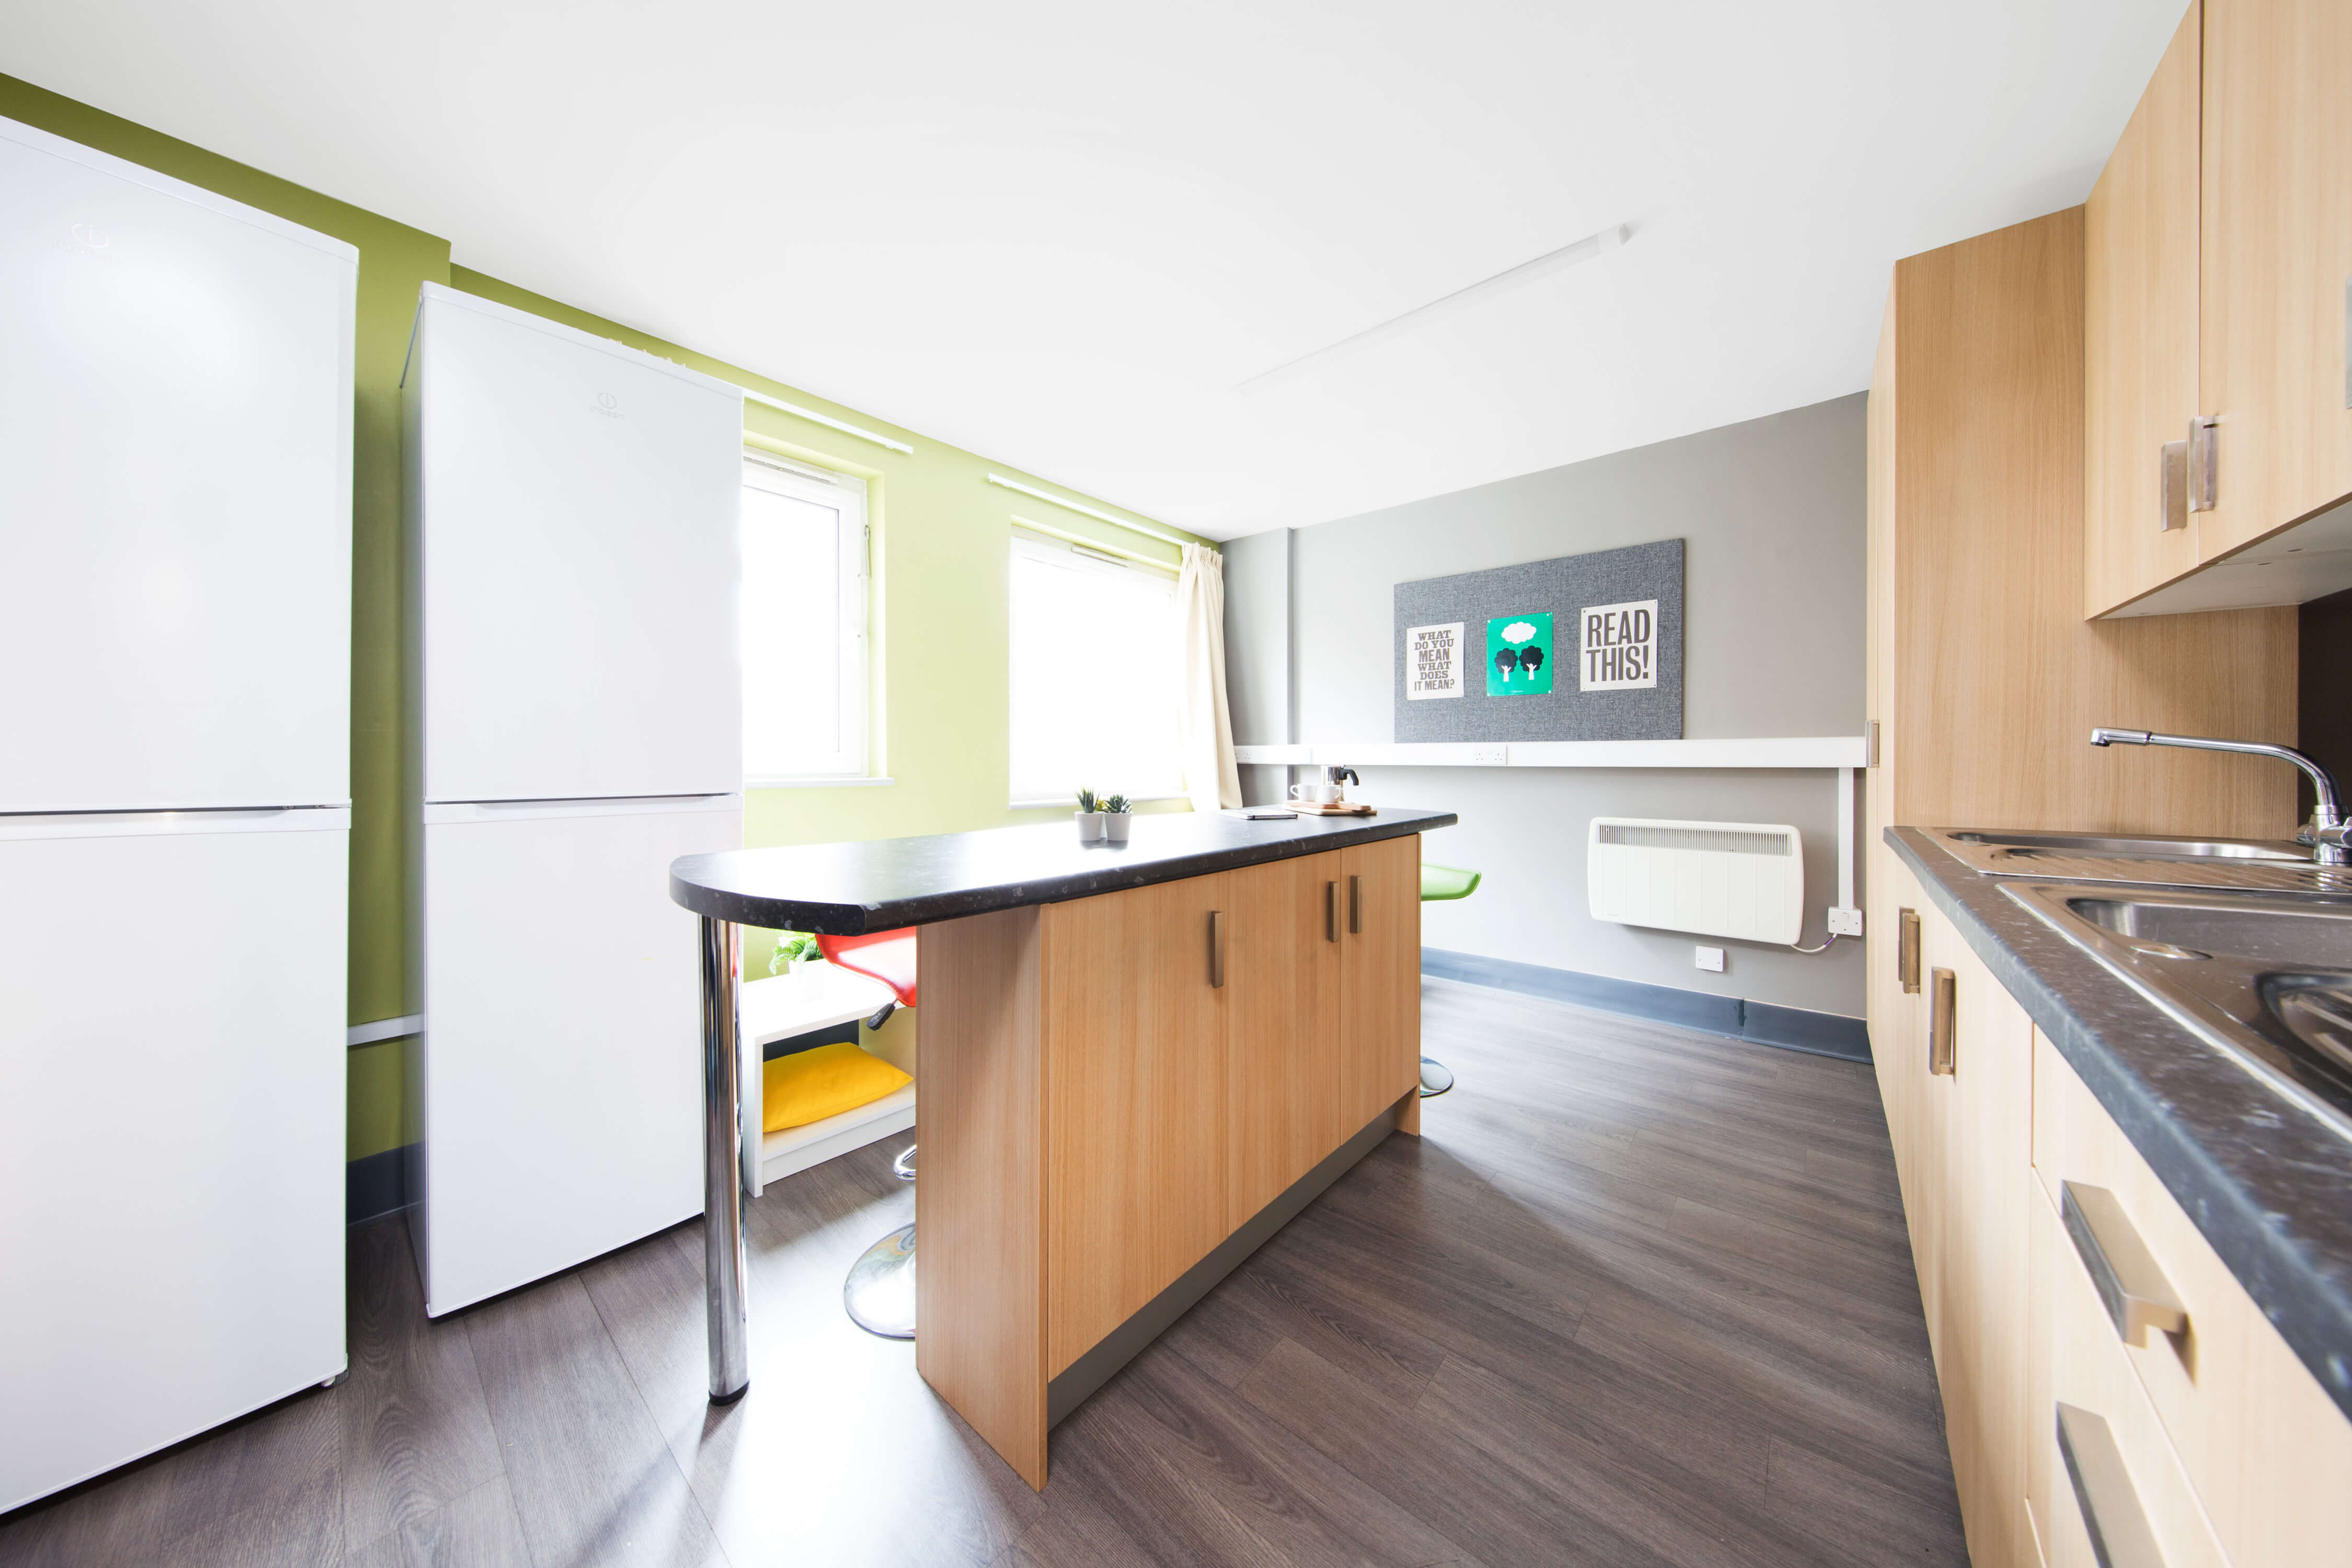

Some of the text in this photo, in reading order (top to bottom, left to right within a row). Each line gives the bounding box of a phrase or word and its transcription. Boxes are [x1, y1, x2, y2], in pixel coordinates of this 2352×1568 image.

[1587, 609, 1651, 648] READ
[1417, 630, 1451, 641] WHAT
[1414, 638, 1455, 650] DO YOU
[1419, 648, 1450, 662] MEAN
[1417, 661, 1451, 671] WHAT
[1586, 645, 1649, 682] THIS!
[1420, 670, 1449, 680] DOES
[1414, 678, 1455, 691] IT MEAN?
